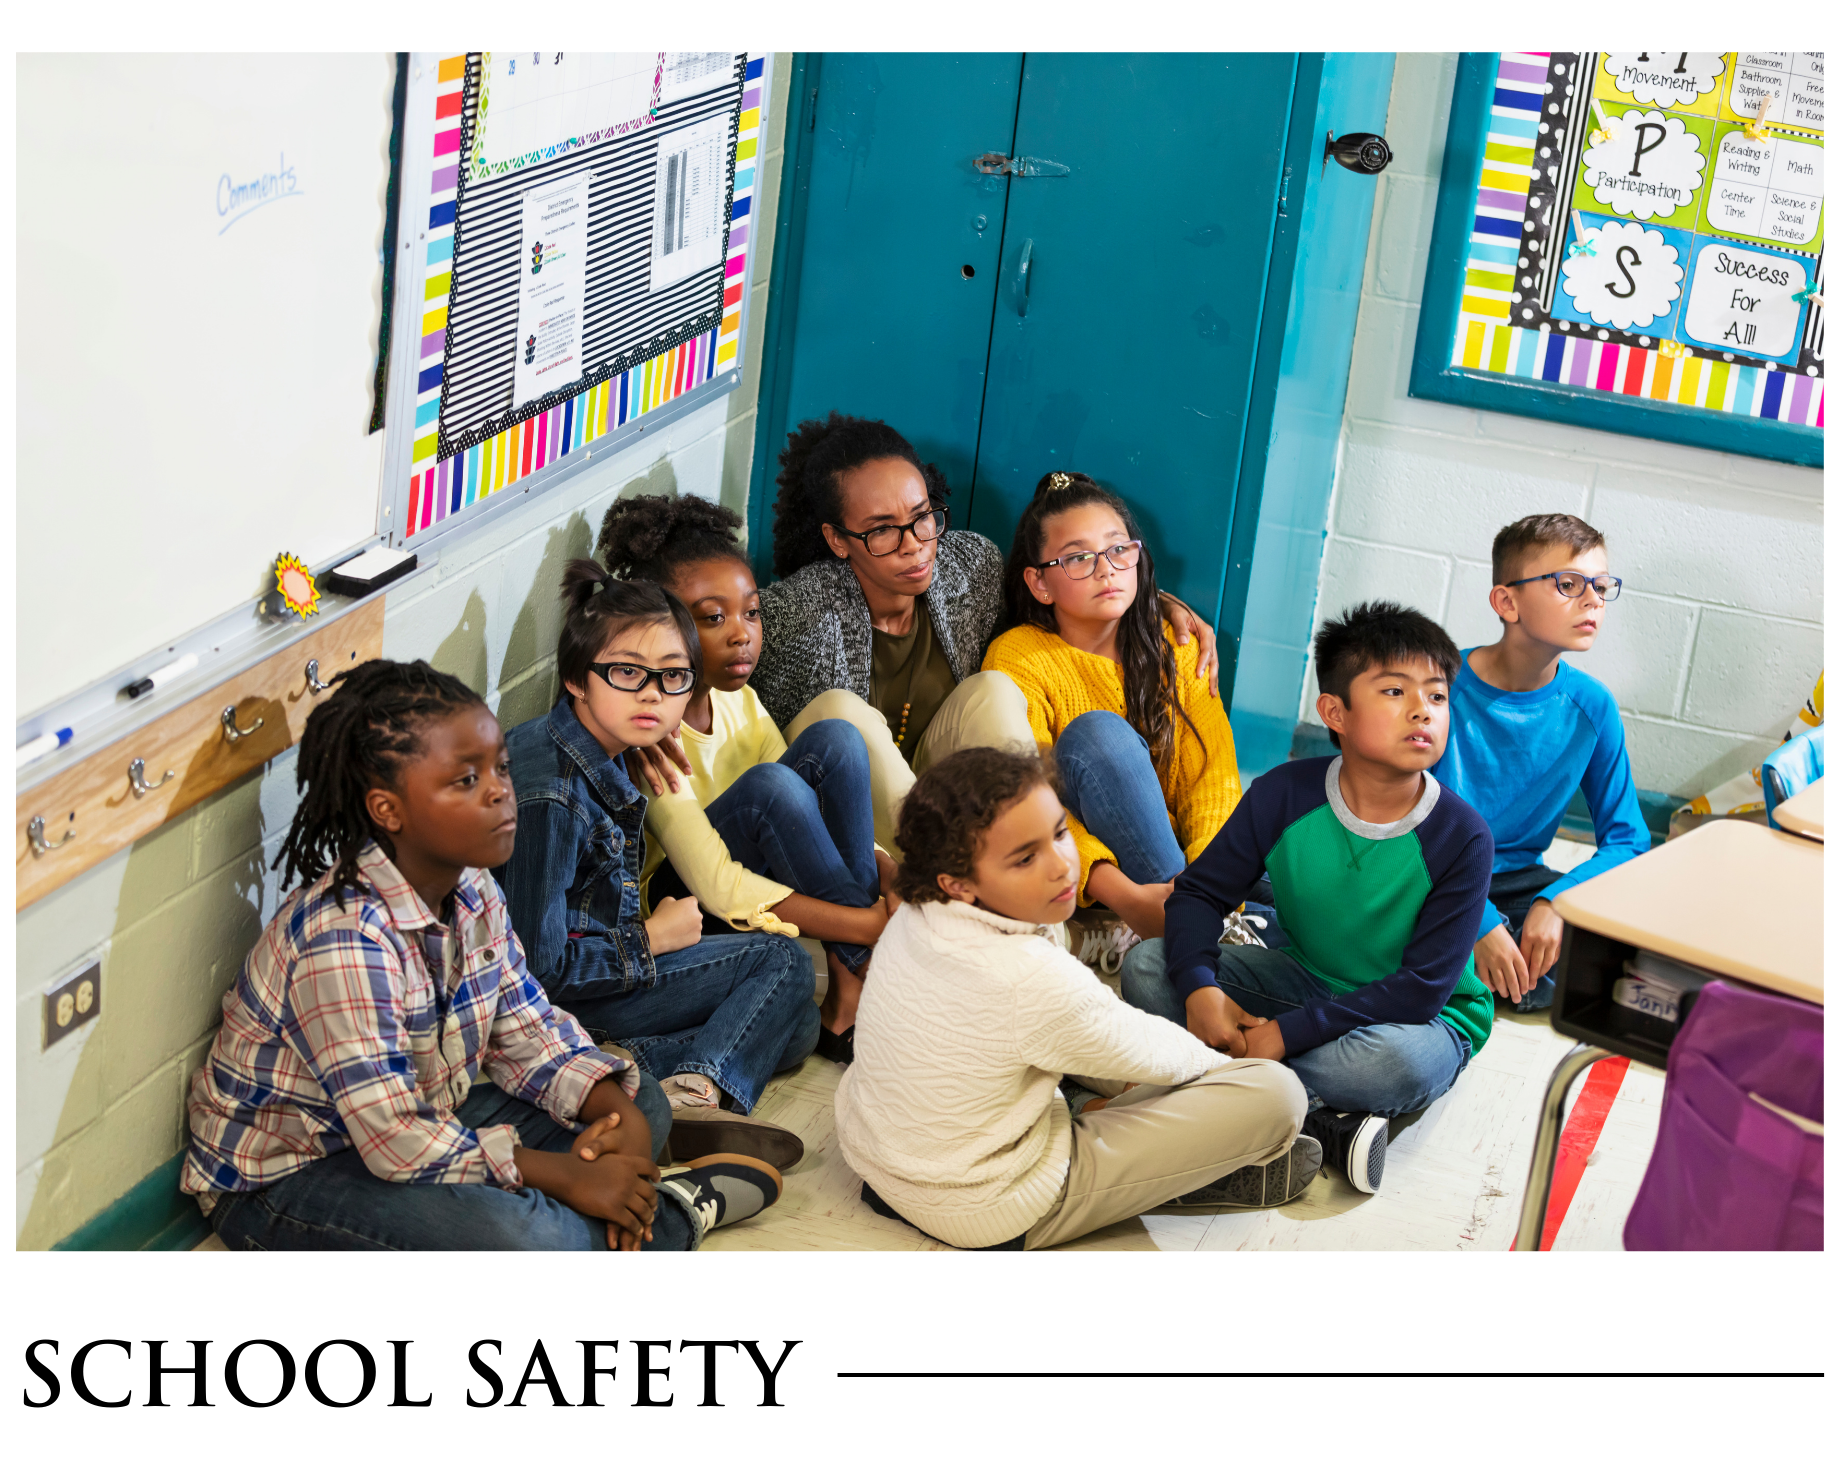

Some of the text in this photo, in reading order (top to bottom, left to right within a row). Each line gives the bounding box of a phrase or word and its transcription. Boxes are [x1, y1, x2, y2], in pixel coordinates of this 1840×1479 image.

[508, 59, 516, 76] 29
[1745, 55, 1783, 70] Classroom
[1622, 66, 1697, 92] Movement
[1741, 70, 1782, 86] Bathroom
[1806, 82, 1824, 93] Free
[1743, 98, 1771, 111] Watr
[1628, 123, 1667, 177] P
[1723, 142, 1770, 160] Reading &
[1728, 159, 1760, 176] Writing
[1787, 160, 1814, 175] Math
[216, 151, 297, 217] Comments
[1597, 171, 1681, 202] Participation
[1721, 189, 1755, 204] Center
[1771, 193, 1817, 211] Science &
[1725, 204, 1746, 218] Time
[1778, 211, 1804, 225] Social
[1771, 224, 1805, 241] Studies
[1604, 245, 1642, 299] S
[1714, 252, 1789, 287] Success
[1730, 288, 1761, 312] For
[1723, 321, 1757, 345] All!
